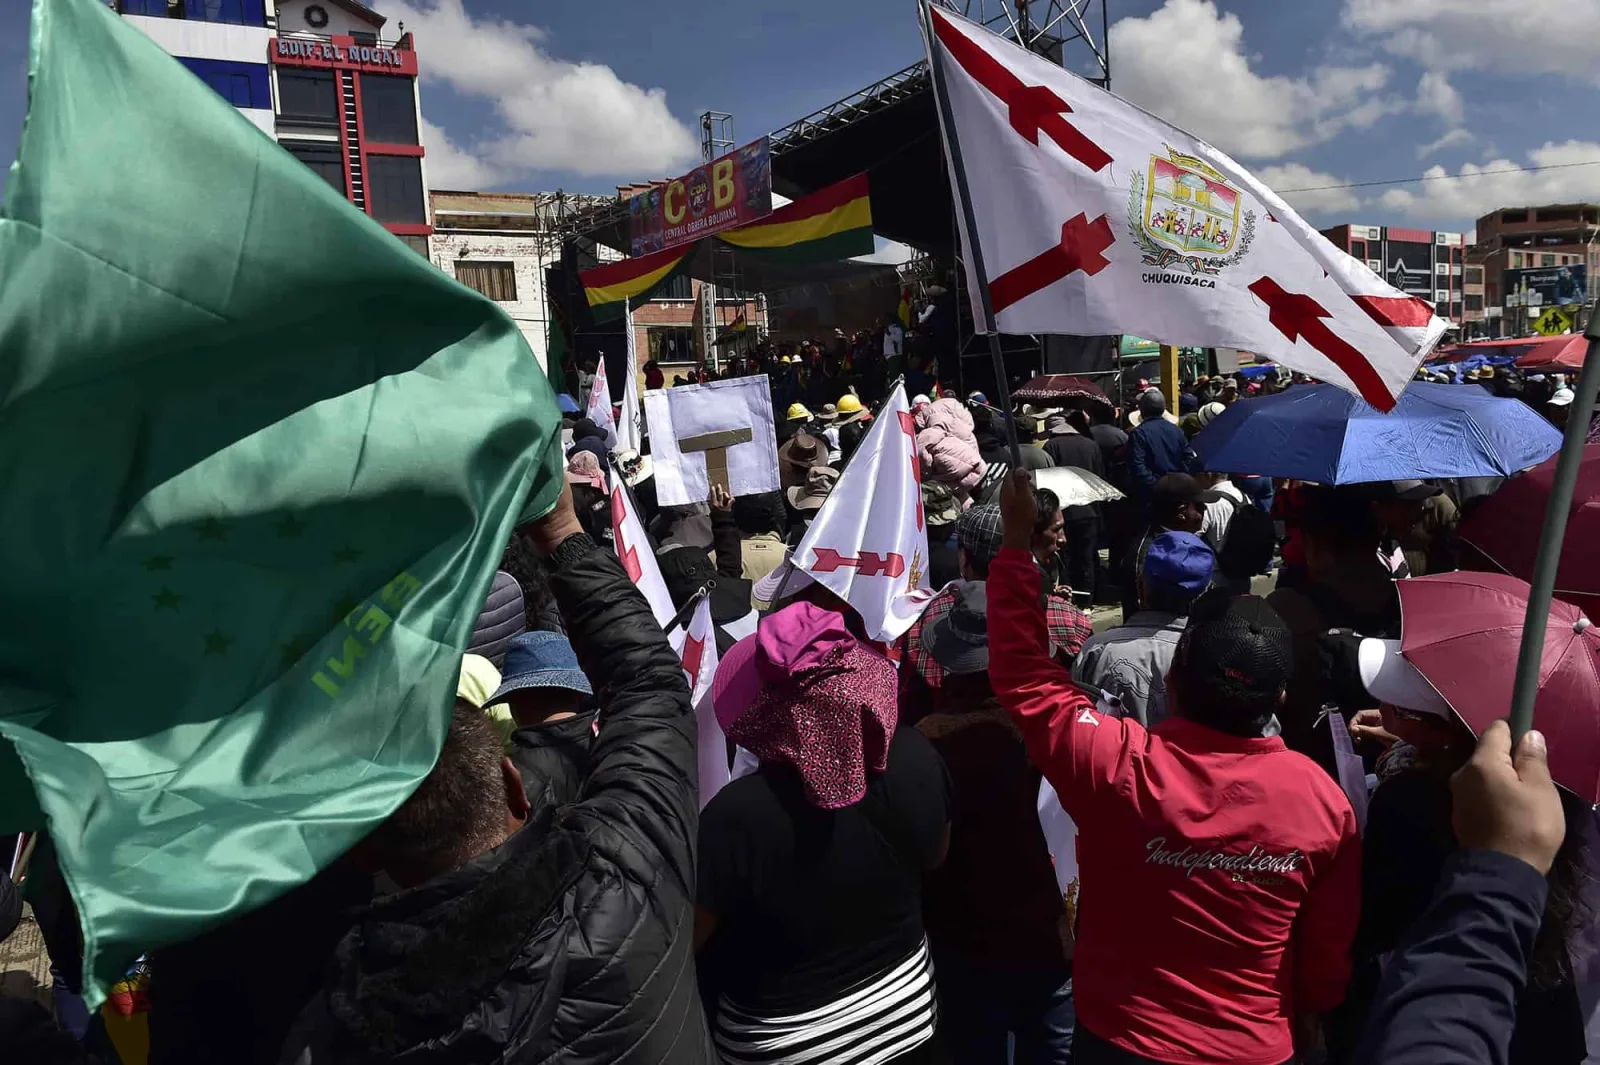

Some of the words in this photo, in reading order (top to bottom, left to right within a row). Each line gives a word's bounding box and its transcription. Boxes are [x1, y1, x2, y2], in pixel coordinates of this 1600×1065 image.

[348, 45, 403, 66] NOGAL
[664, 224, 687, 240] CENTRAL
[687, 217, 709, 233] OBRERA
[708, 206, 737, 226] BOLIVIANA
[1142, 273, 1216, 289] CHUQUISACA
[704, 290, 713, 359] FARMACIA
[1145, 836, 1304, 878] Independiente
